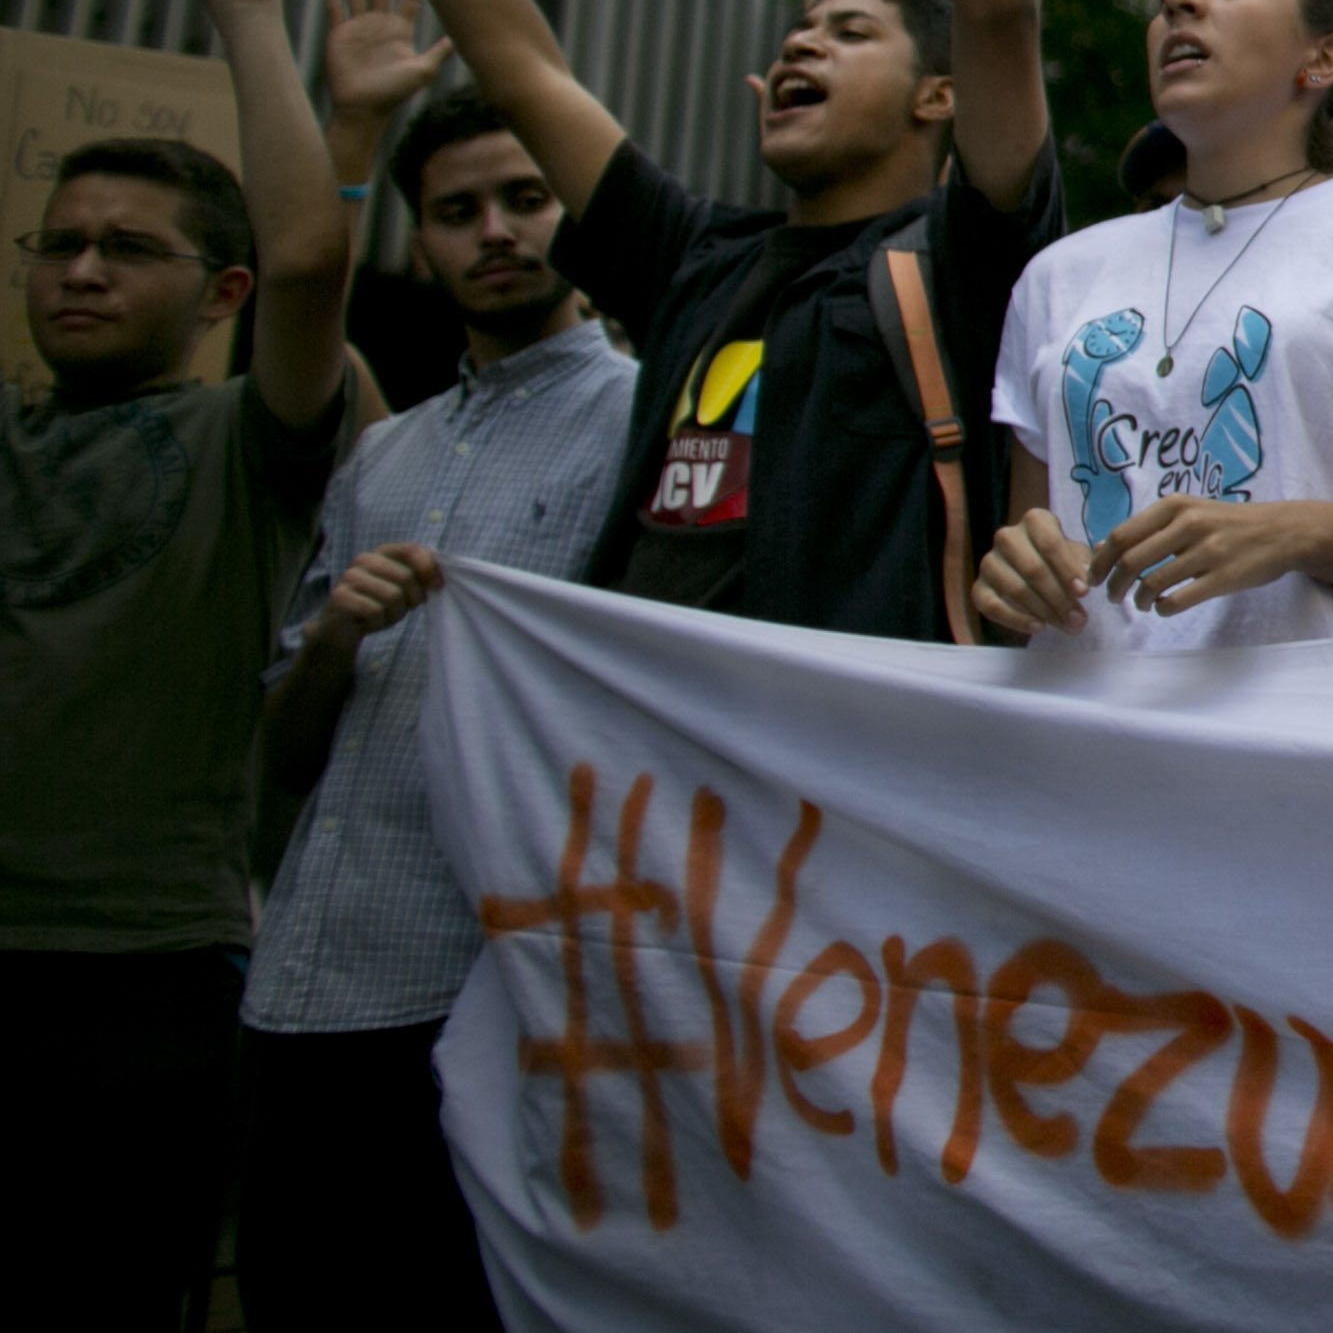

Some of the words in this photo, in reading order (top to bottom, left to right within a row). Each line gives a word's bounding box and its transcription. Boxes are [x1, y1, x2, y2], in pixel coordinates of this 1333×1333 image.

[1098, 413, 1200, 473] Creo
[1157, 468, 1191, 499] en
[1200, 453, 1223, 496] la
